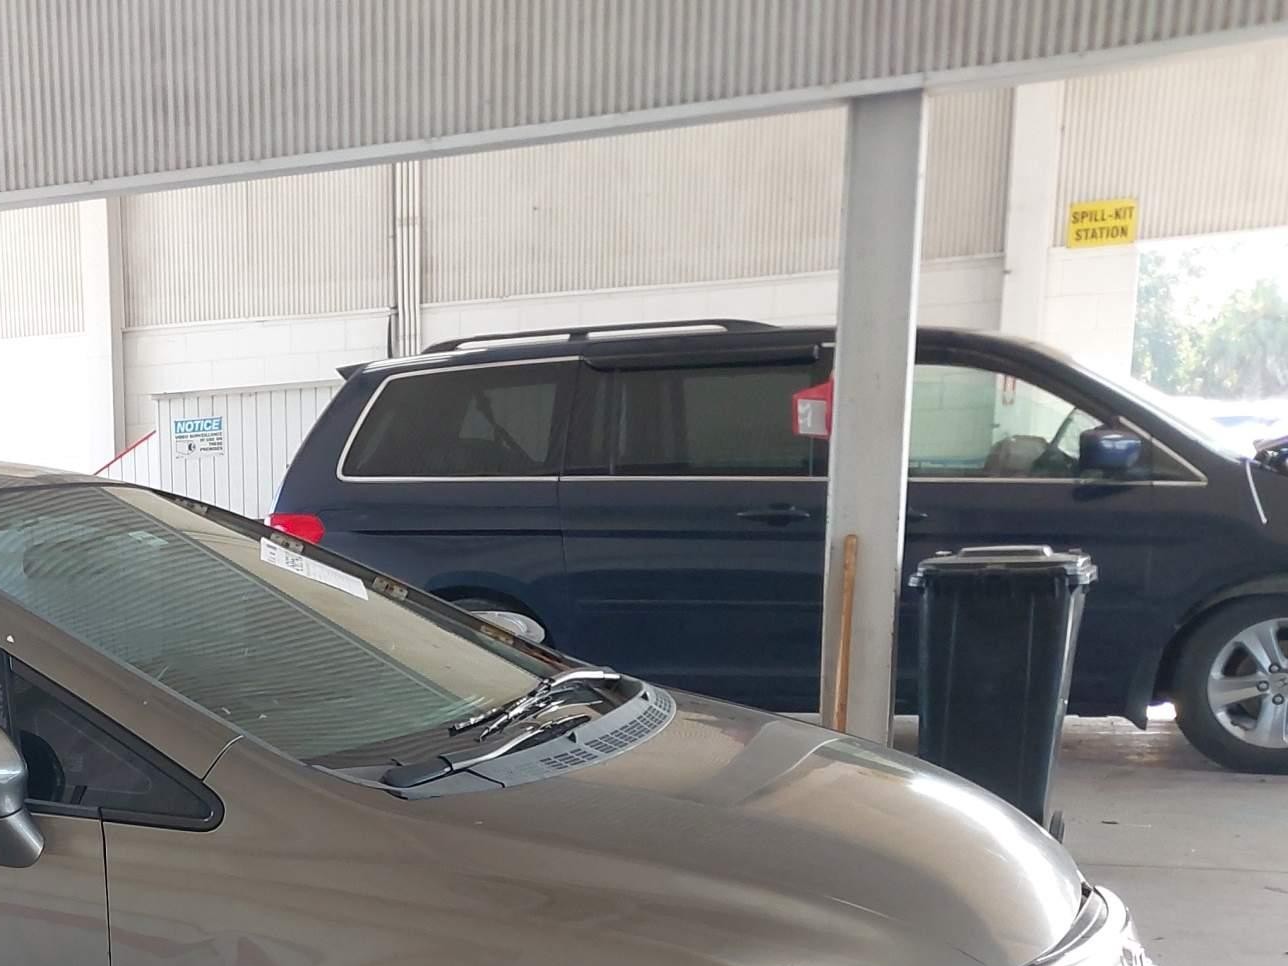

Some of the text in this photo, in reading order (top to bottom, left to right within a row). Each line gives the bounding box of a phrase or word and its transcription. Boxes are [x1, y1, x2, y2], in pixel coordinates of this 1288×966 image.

[1072, 206, 1135, 224] SPILL-KIT
[1075, 225, 1129, 242] STATION
[177, 420, 220, 433] NOTICE
